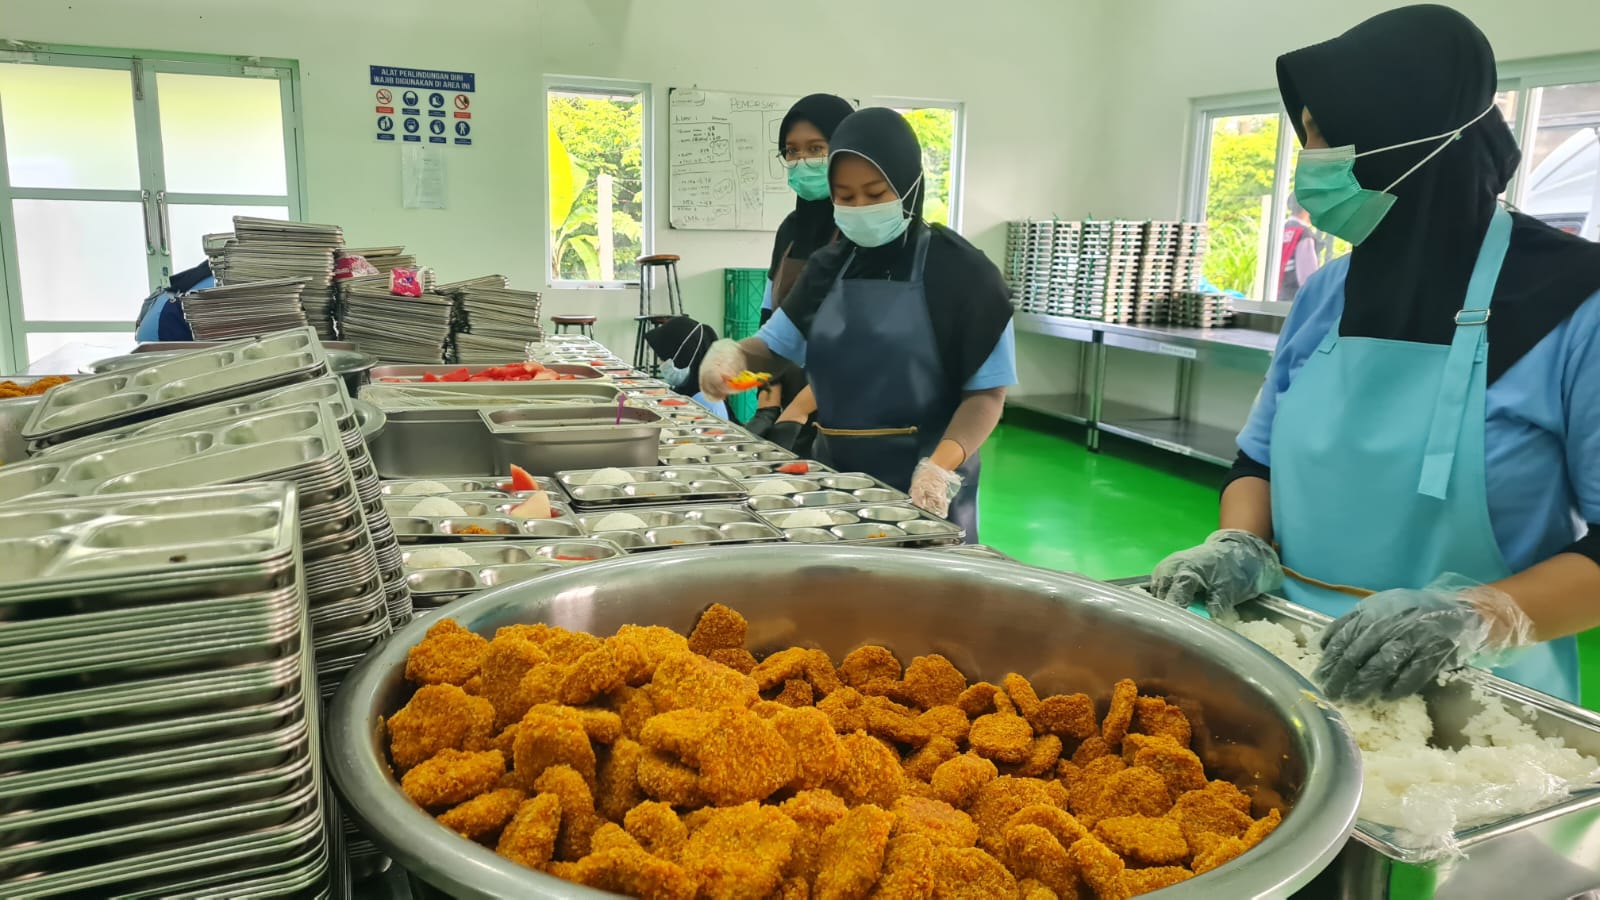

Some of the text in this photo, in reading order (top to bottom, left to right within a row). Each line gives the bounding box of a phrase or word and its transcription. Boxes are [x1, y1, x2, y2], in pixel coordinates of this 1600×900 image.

[381, 69, 464, 82] ALAT PERLINDUNGAN DIRI
[373, 76, 471, 90] WAJIB DIGUNAKAN DI AREA INI
